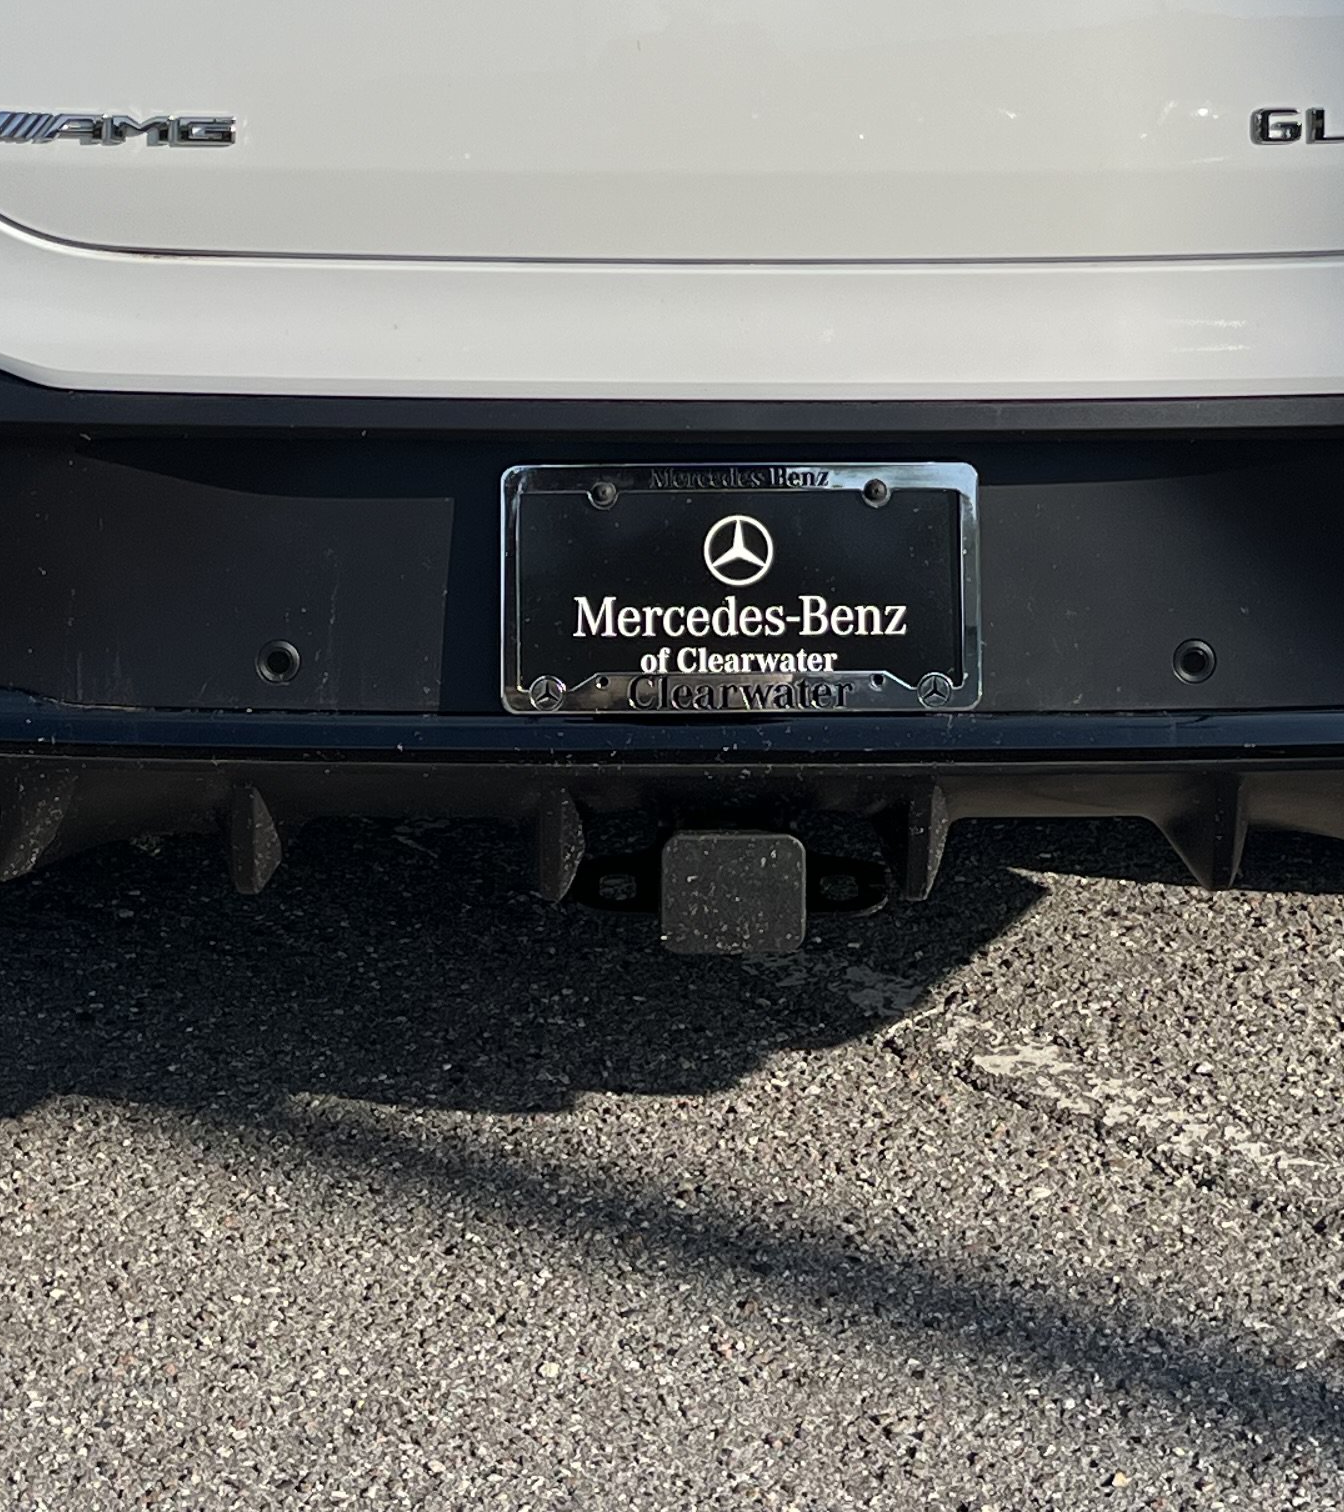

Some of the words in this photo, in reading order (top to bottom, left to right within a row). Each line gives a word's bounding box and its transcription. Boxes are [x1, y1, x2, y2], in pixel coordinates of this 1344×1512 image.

[572, 595, 908, 637] Mercedes-Benz
[640, 647, 670, 673] of
[676, 647, 838, 672] Clearwater
[628, 675, 854, 710] Clearwater
